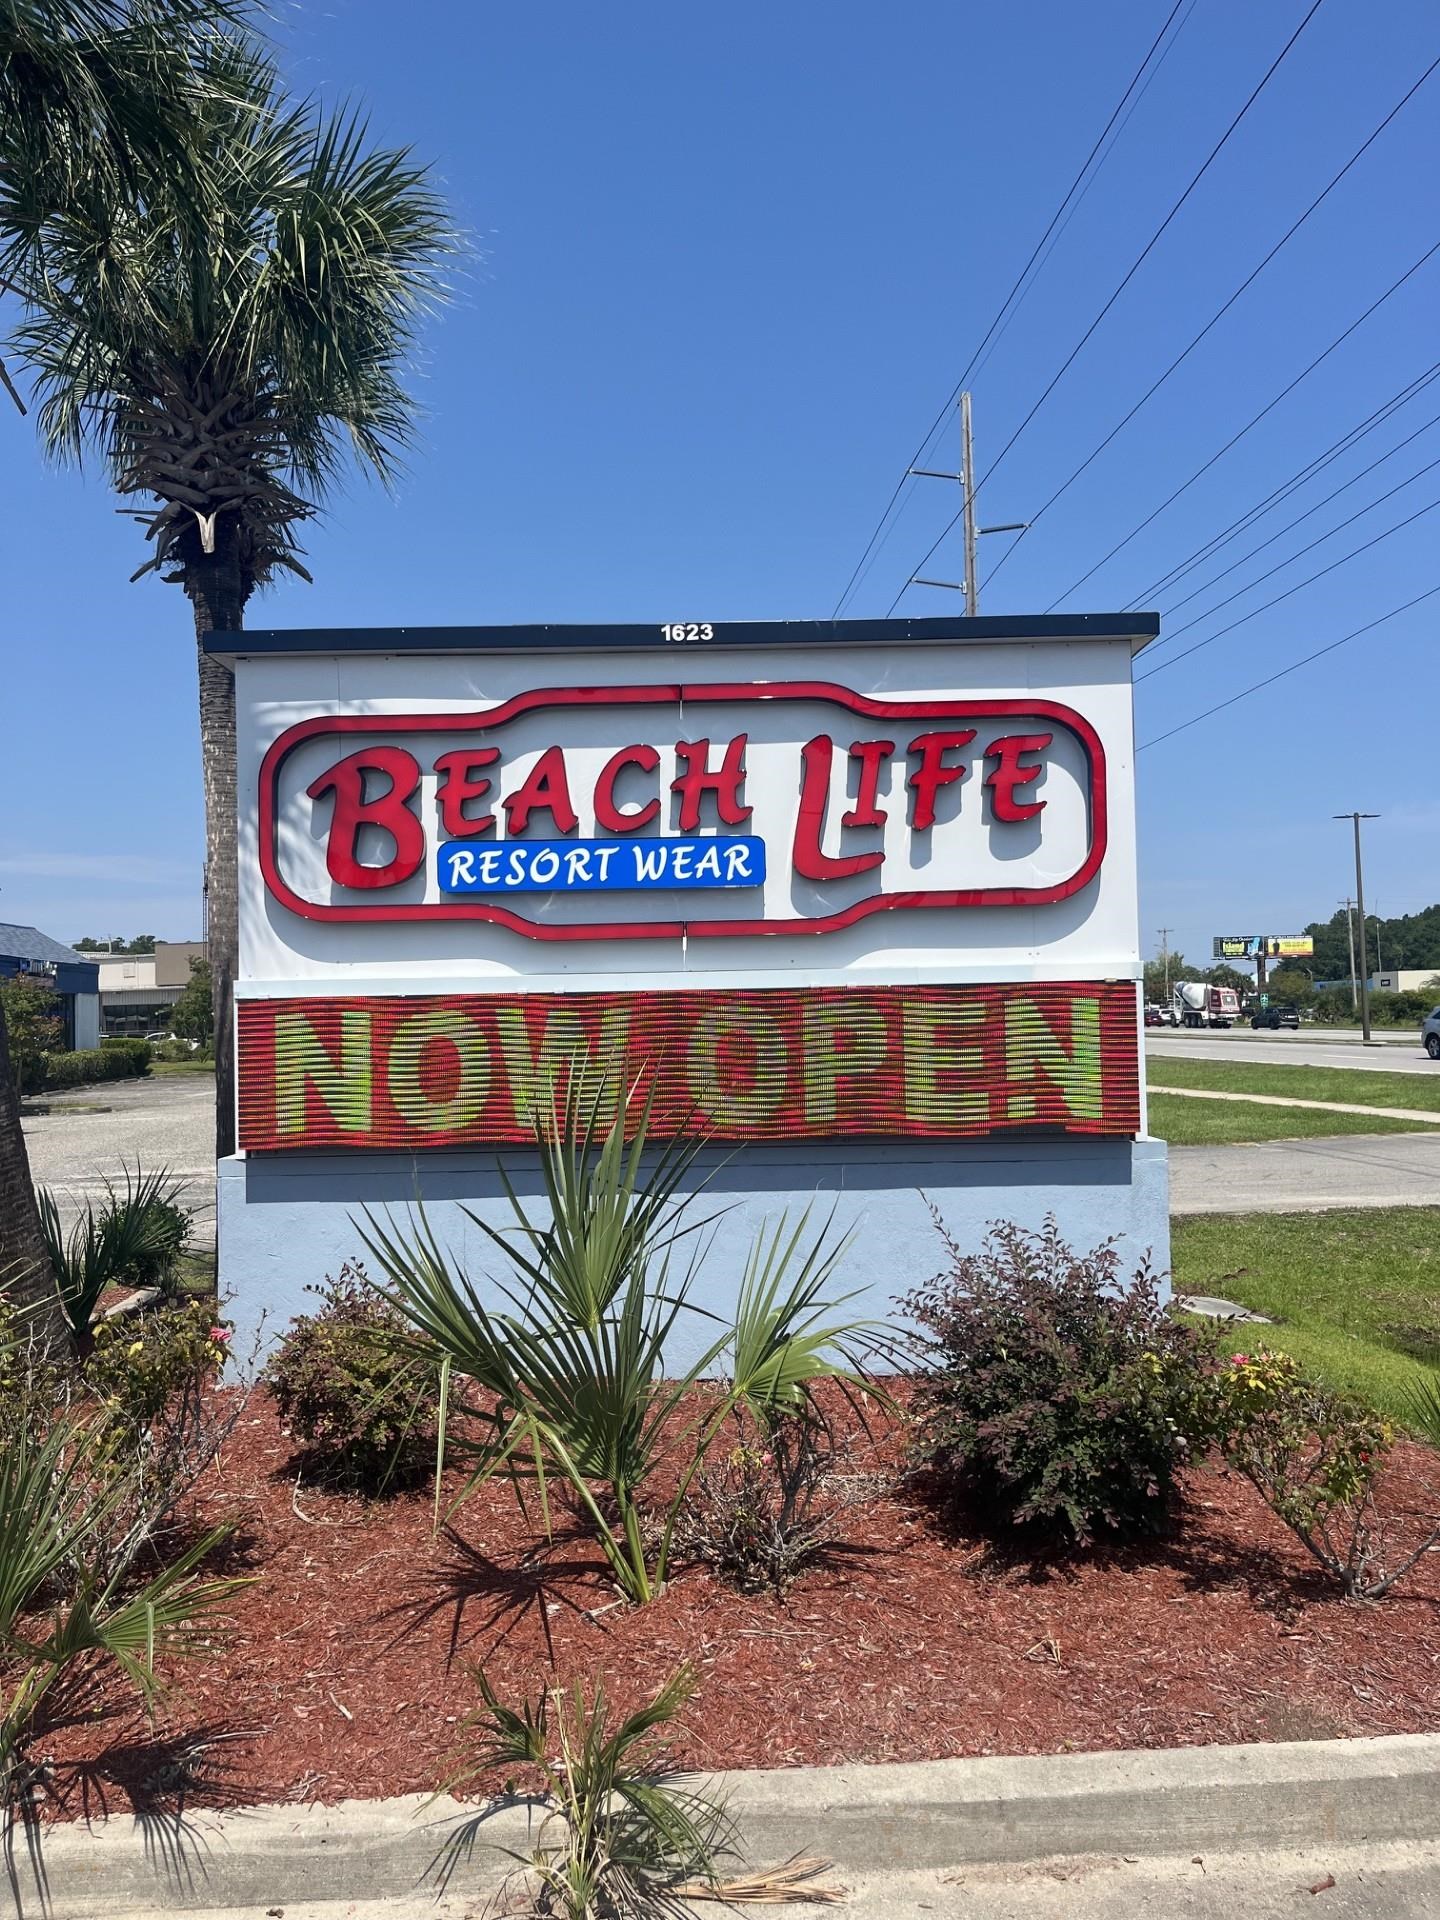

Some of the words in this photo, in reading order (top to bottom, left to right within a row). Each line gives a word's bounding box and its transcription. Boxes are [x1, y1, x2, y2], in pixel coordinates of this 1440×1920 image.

[661, 624, 713, 641] 1623
[306, 733, 754, 889] BEACH
[793, 729, 1053, 880] LIFE
[448, 846, 619, 887] RESORT
[630, 844, 753, 882] WEAR
[275, 1008, 633, 1133] NOW
[687, 997, 1103, 1125] OPEN
